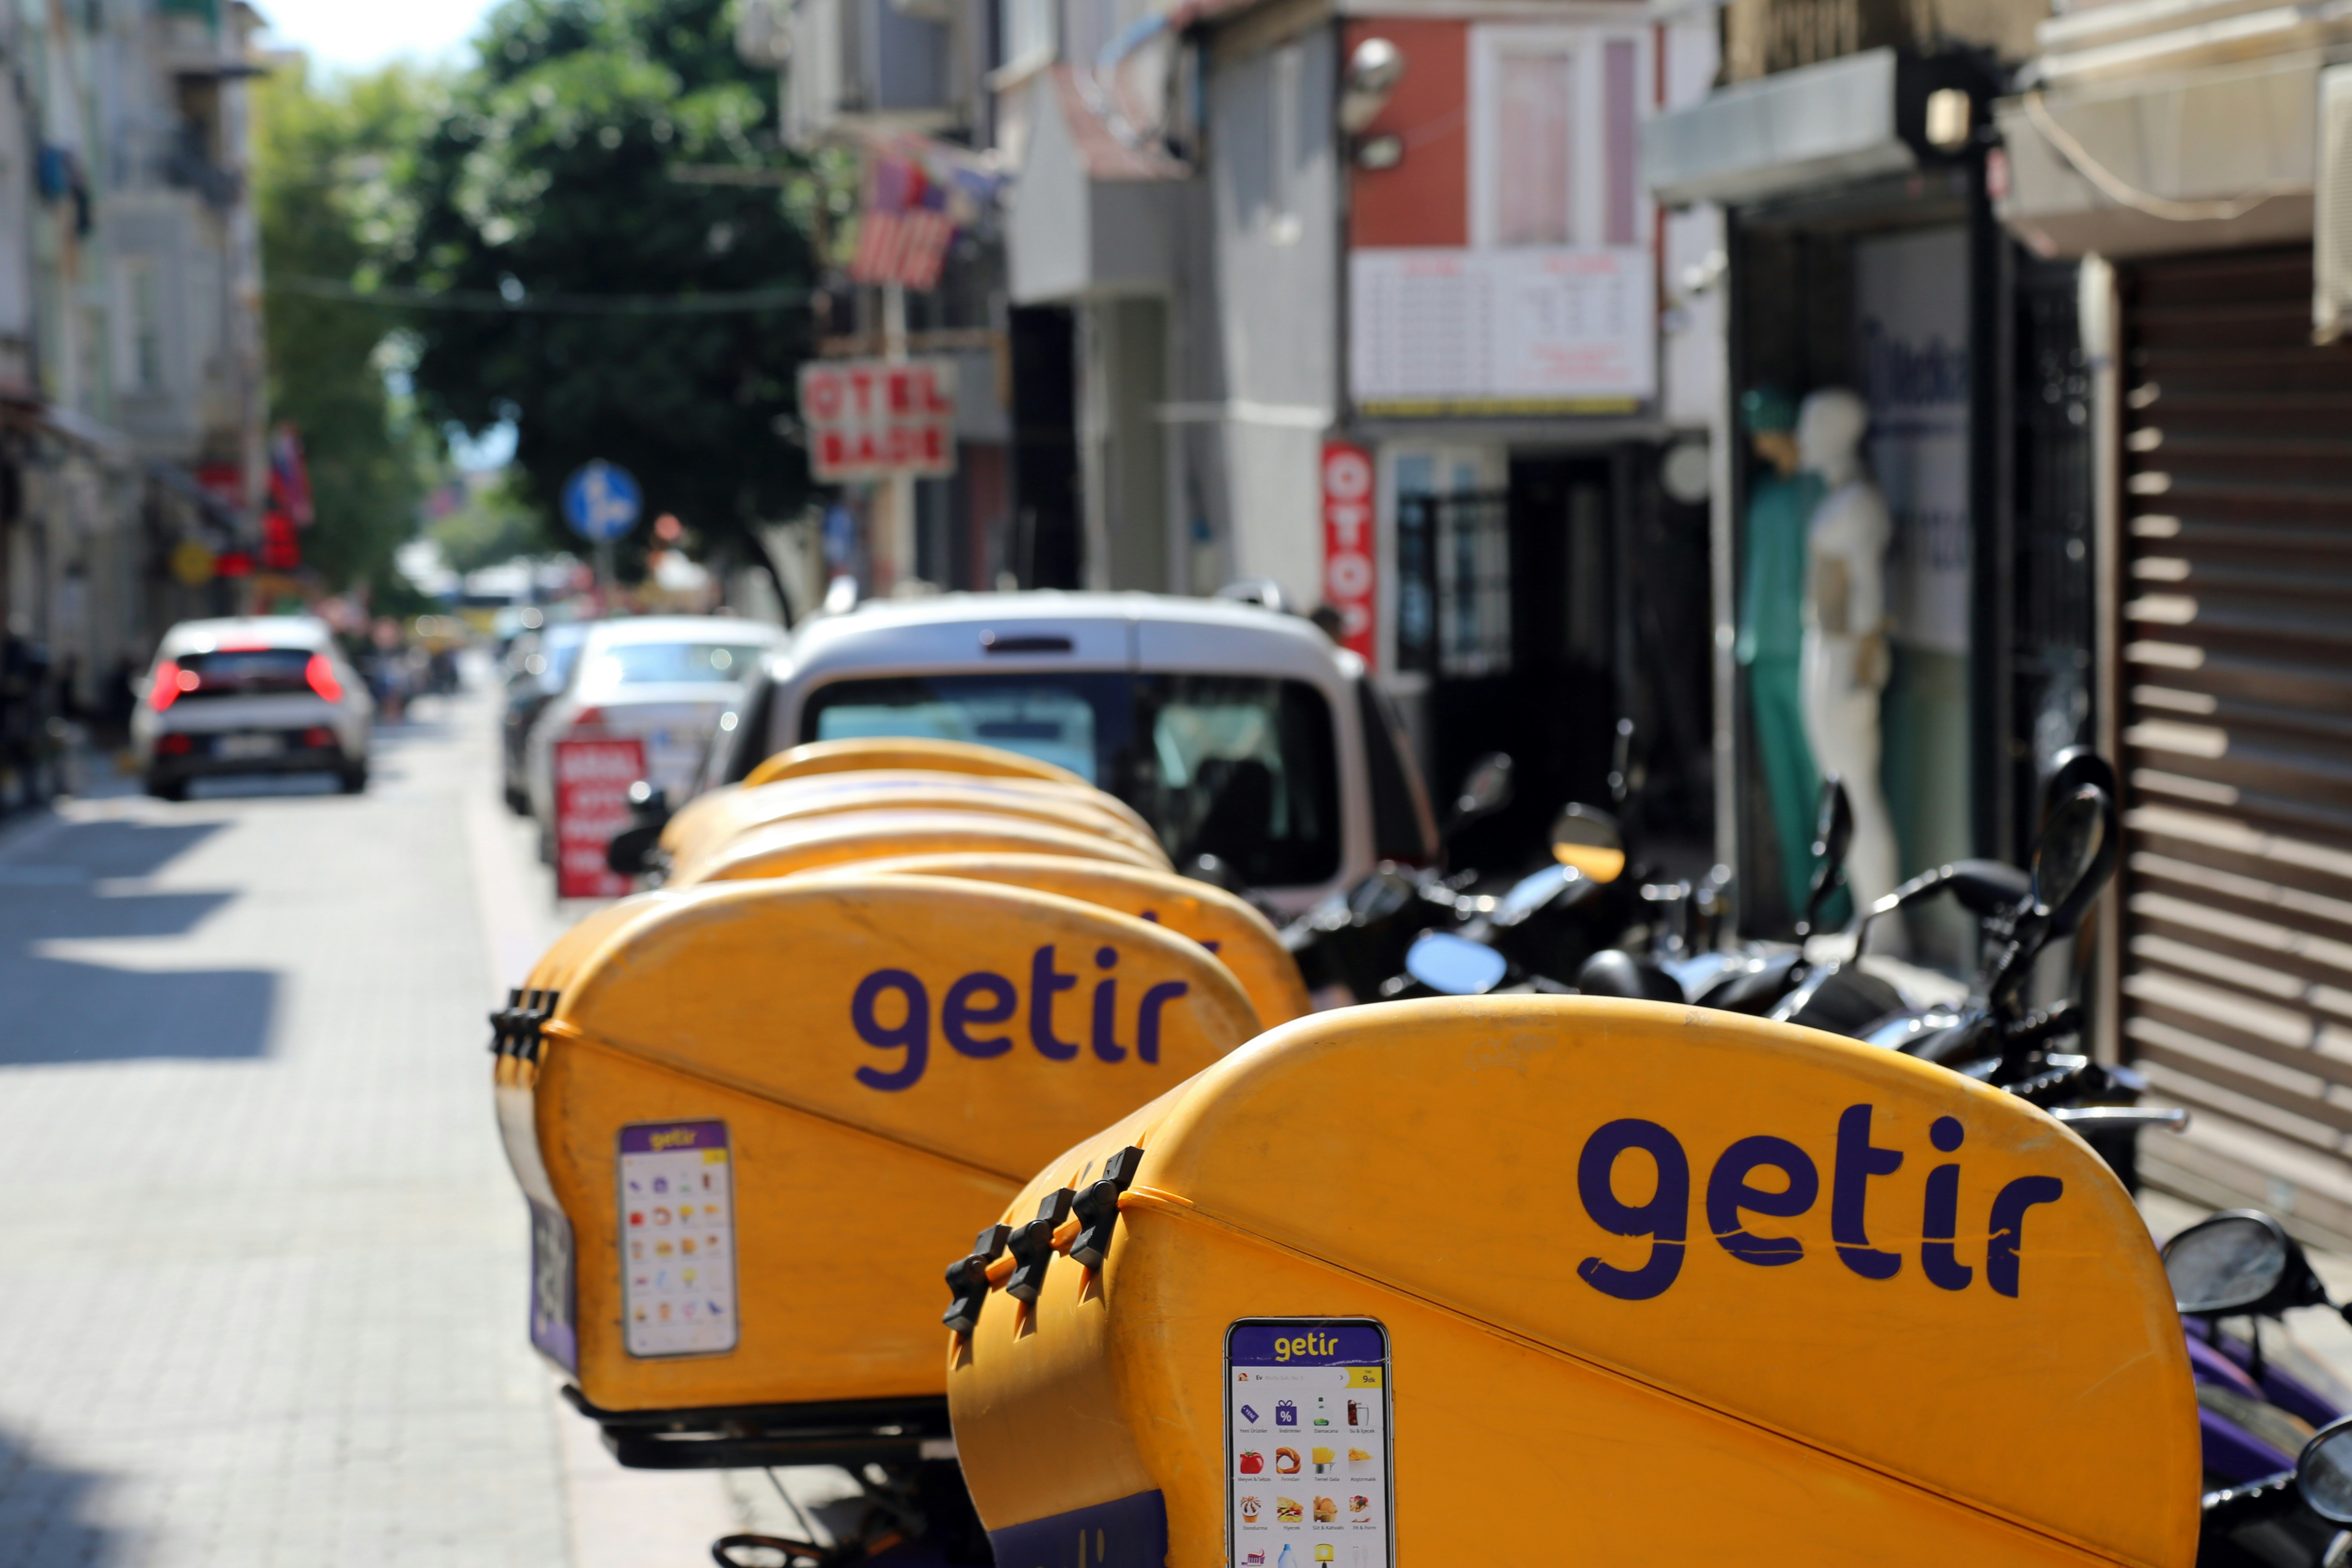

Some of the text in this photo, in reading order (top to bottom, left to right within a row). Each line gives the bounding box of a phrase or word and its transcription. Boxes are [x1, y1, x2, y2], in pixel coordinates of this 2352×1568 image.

[805, 368, 955, 419] OTEL
[851, 945, 1189, 1092] getir
[1577, 1104, 2063, 1300] getir
[1274, 1332, 1338, 1362] getir
[1280, 1411, 1292, 1422] %
